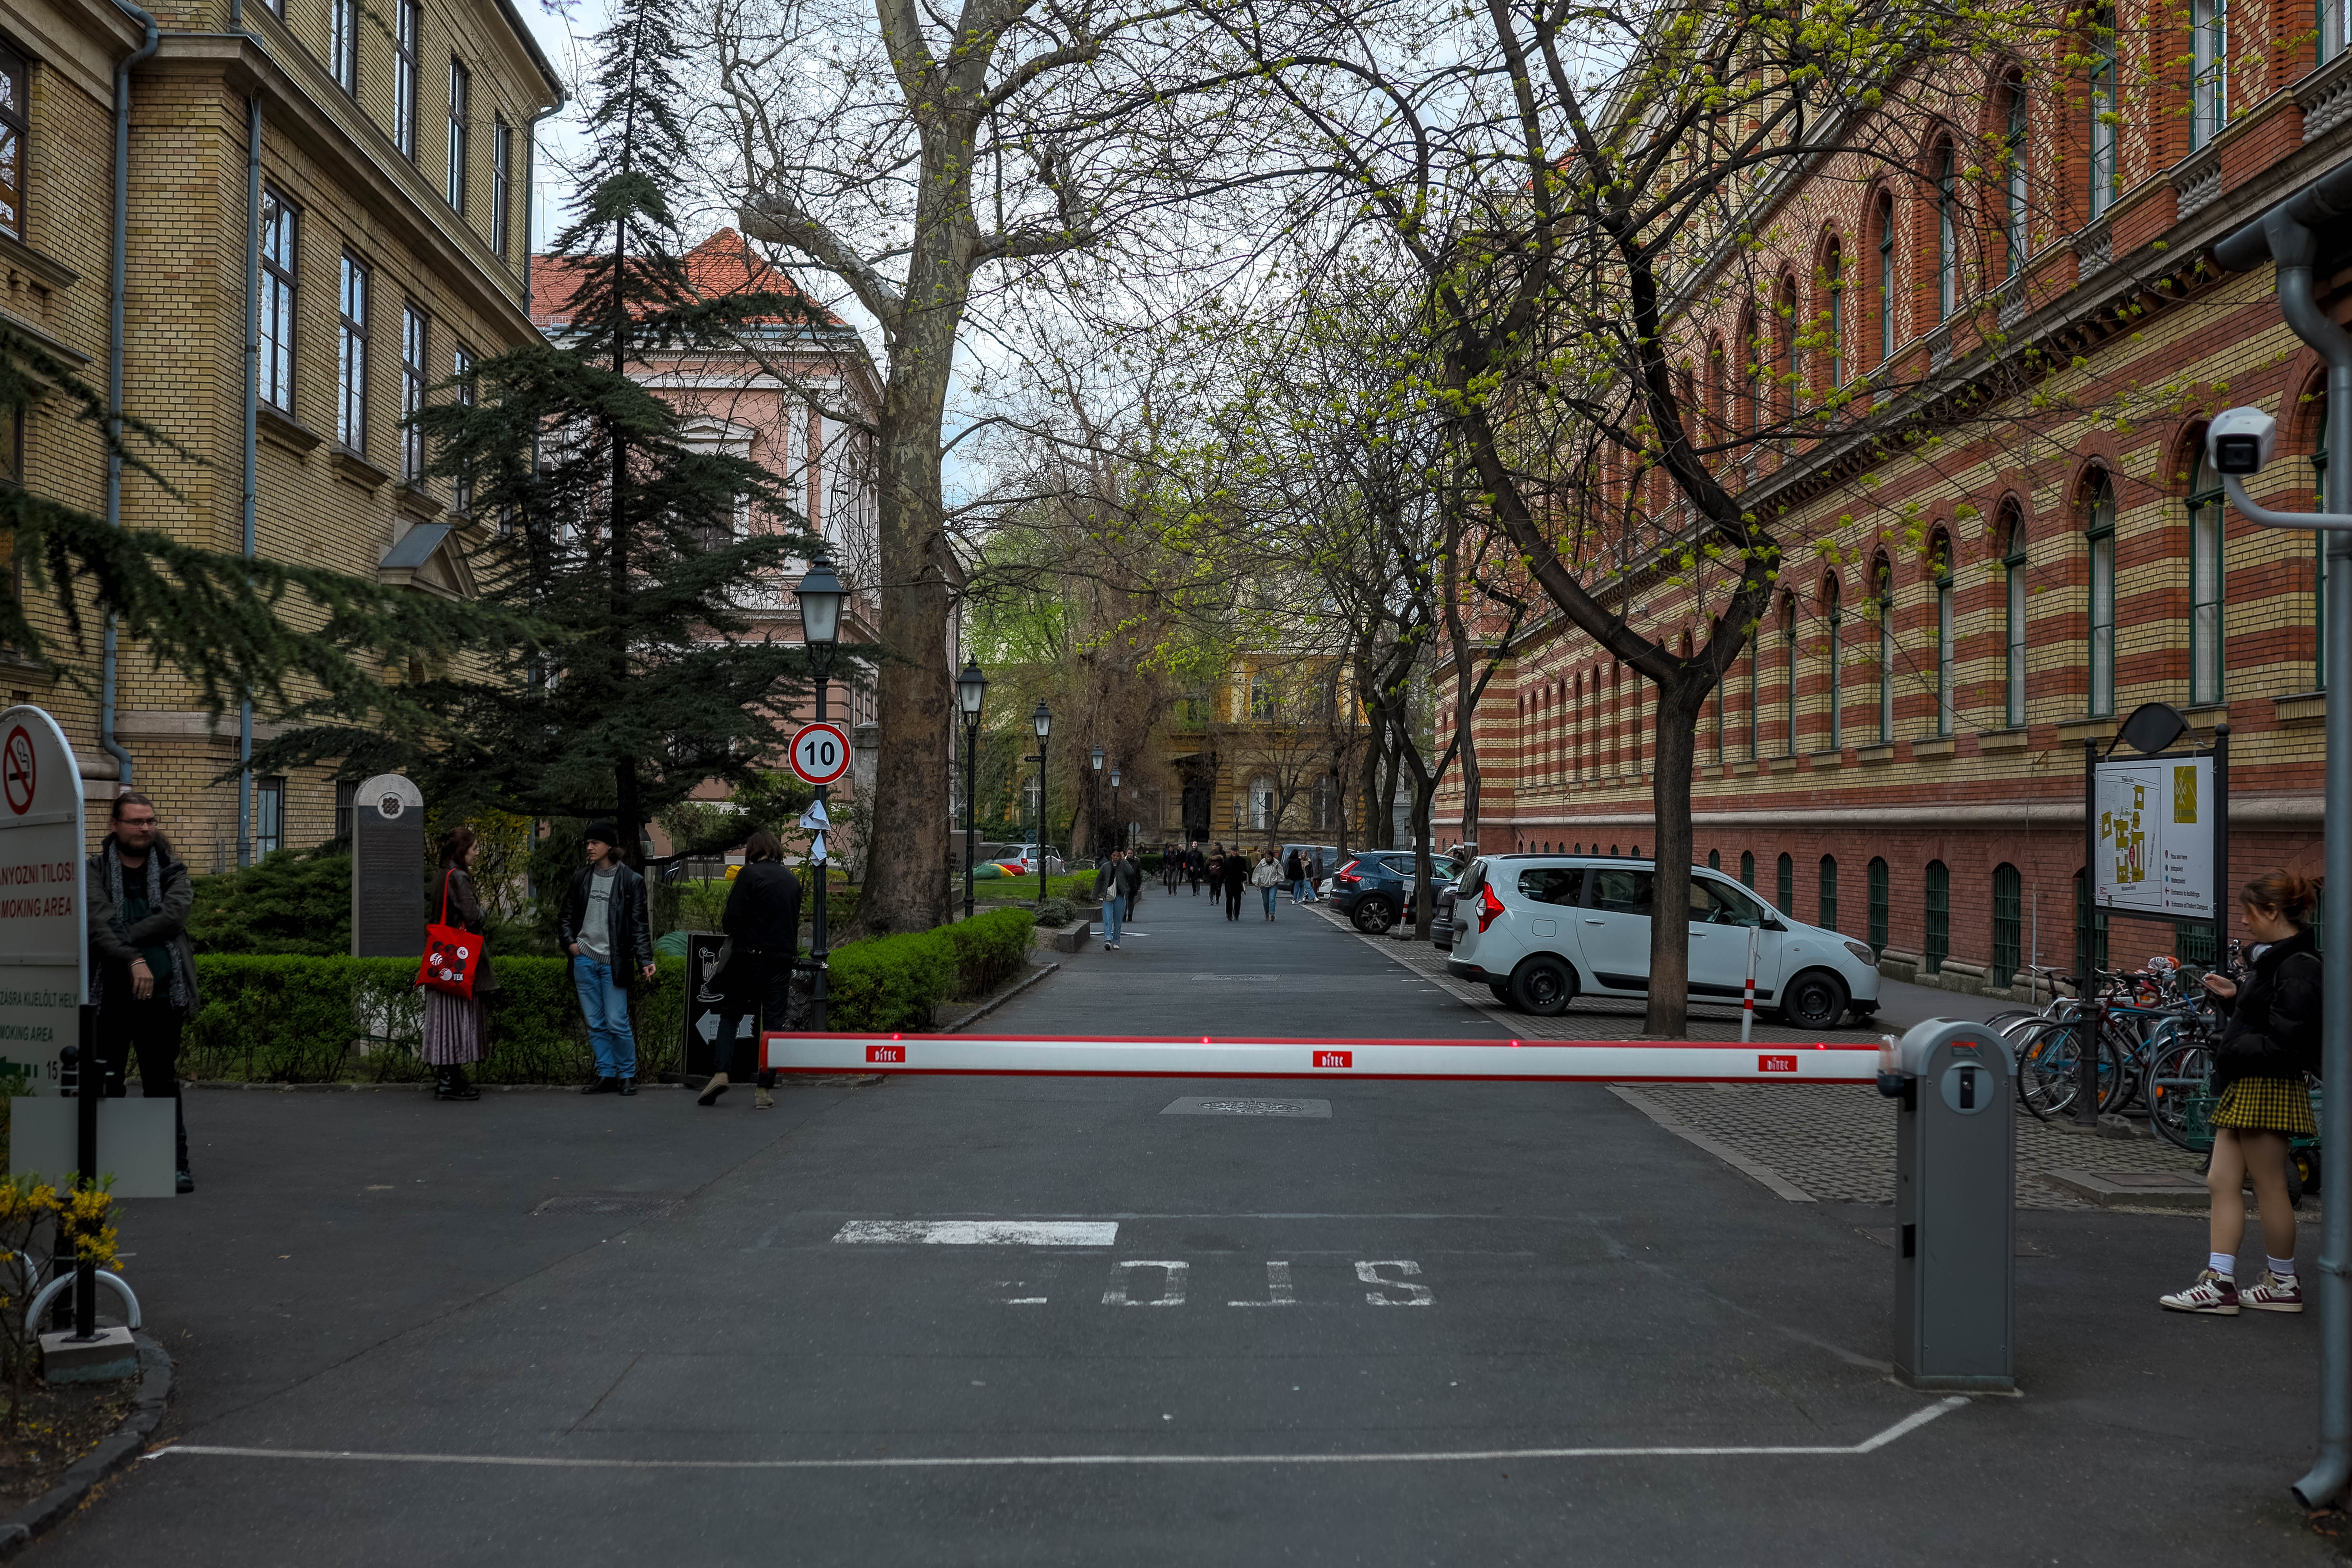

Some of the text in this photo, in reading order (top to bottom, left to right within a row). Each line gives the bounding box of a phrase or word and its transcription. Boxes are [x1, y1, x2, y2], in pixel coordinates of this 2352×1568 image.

[805, 741, 835, 766] 10
[0, 862, 75, 886] NYOZNI TILOS!
[43, 897, 72, 917] AREA
[59, 993, 77, 1008] HELY
[30, 1027, 53, 1042] AREA
[46, 1060, 58, 1080] 15
